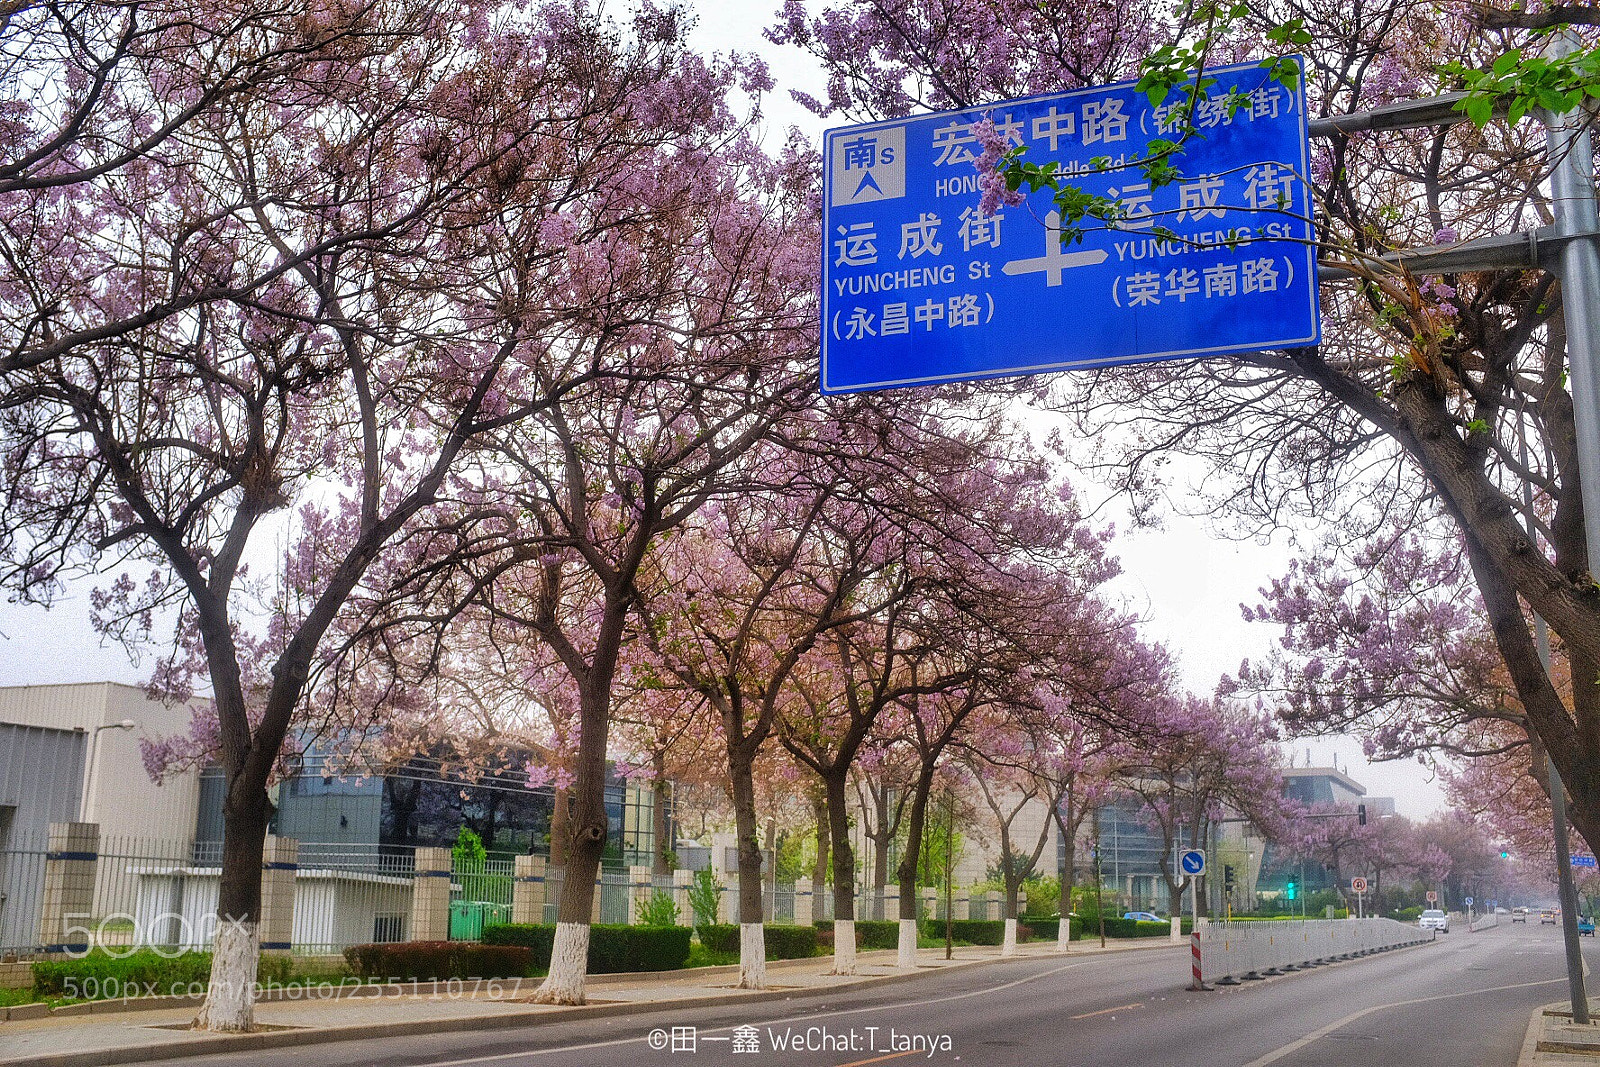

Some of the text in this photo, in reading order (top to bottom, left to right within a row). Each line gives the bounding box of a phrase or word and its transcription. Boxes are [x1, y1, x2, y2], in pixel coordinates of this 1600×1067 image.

[1107, 163, 1296, 231] 运成街
[834, 205, 1005, 268] 运成街
[1114, 222, 1292, 262] YUNCHENG St
[834, 260, 991, 297] YUNCHENG St
[1112, 255, 1294, 308] (荣华南路)
[832, 292, 995, 341] (永昌中路)
